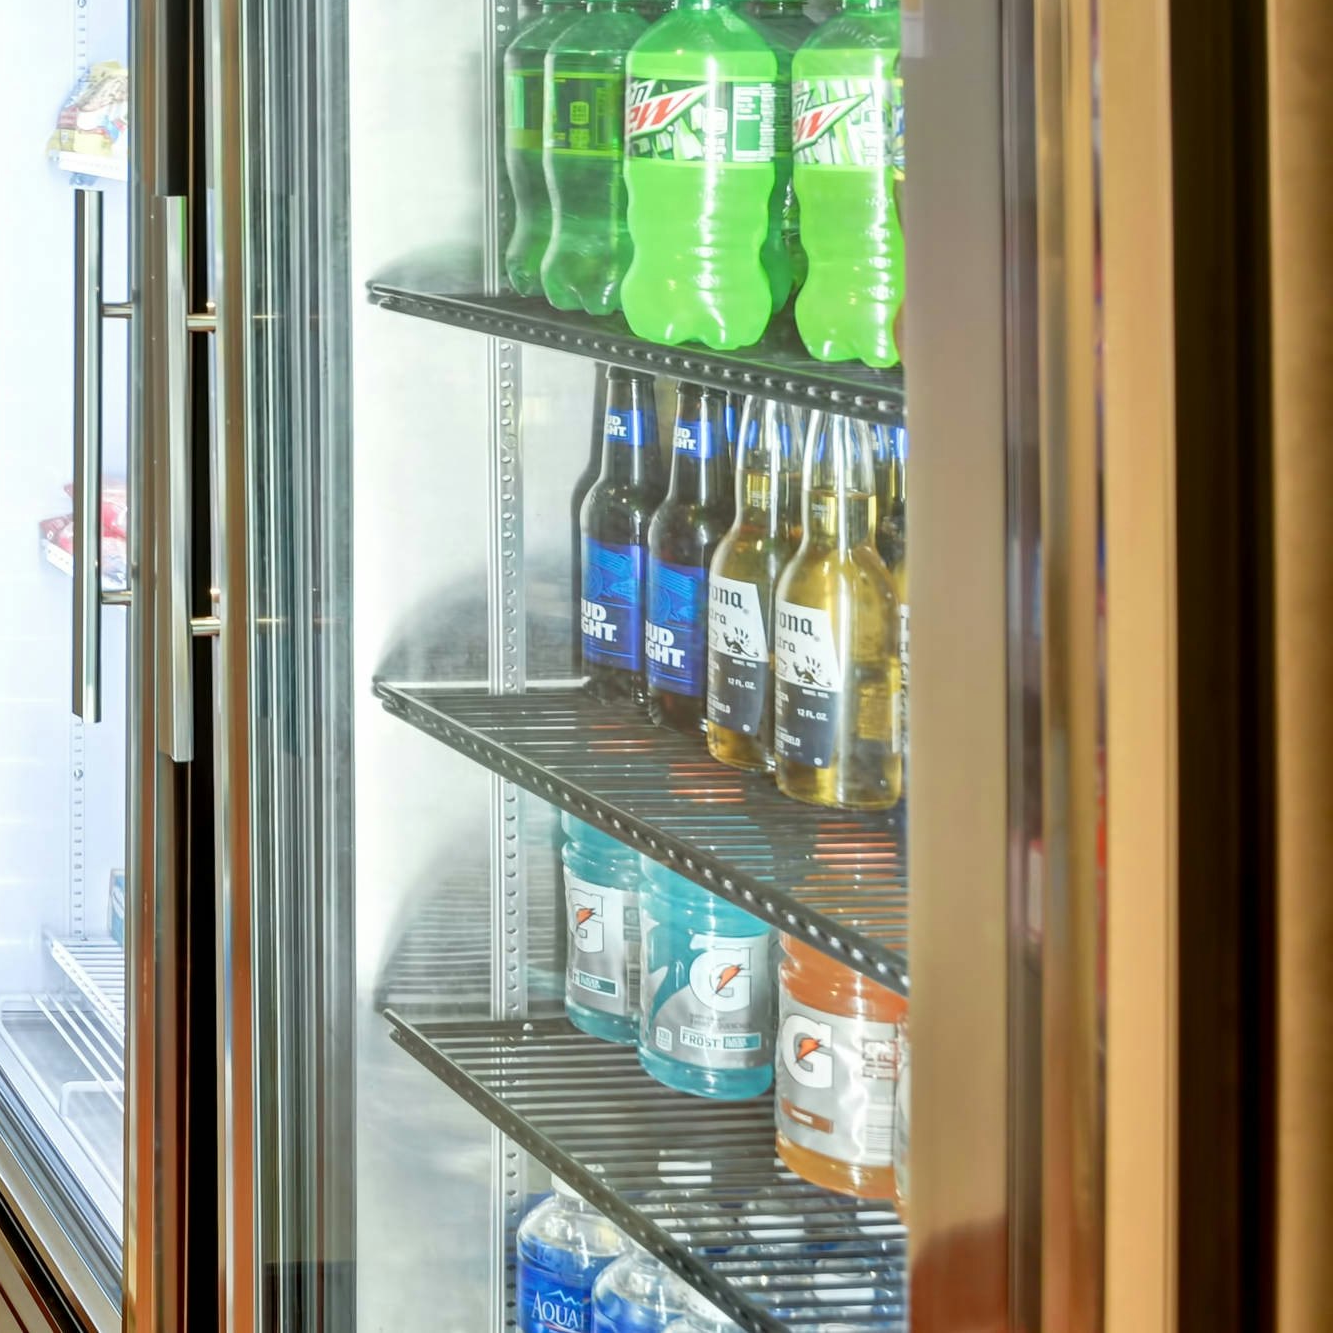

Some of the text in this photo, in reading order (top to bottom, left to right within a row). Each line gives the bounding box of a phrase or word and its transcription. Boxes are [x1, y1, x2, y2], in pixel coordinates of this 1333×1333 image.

[581, 597, 607, 622] UD
[712, 585, 743, 610] ona
[581, 616, 618, 643] GHT.
[777, 610, 814, 637] ona
[682, 1033, 719, 1049] FROST
[532, 1290, 579, 1330] AQUA
